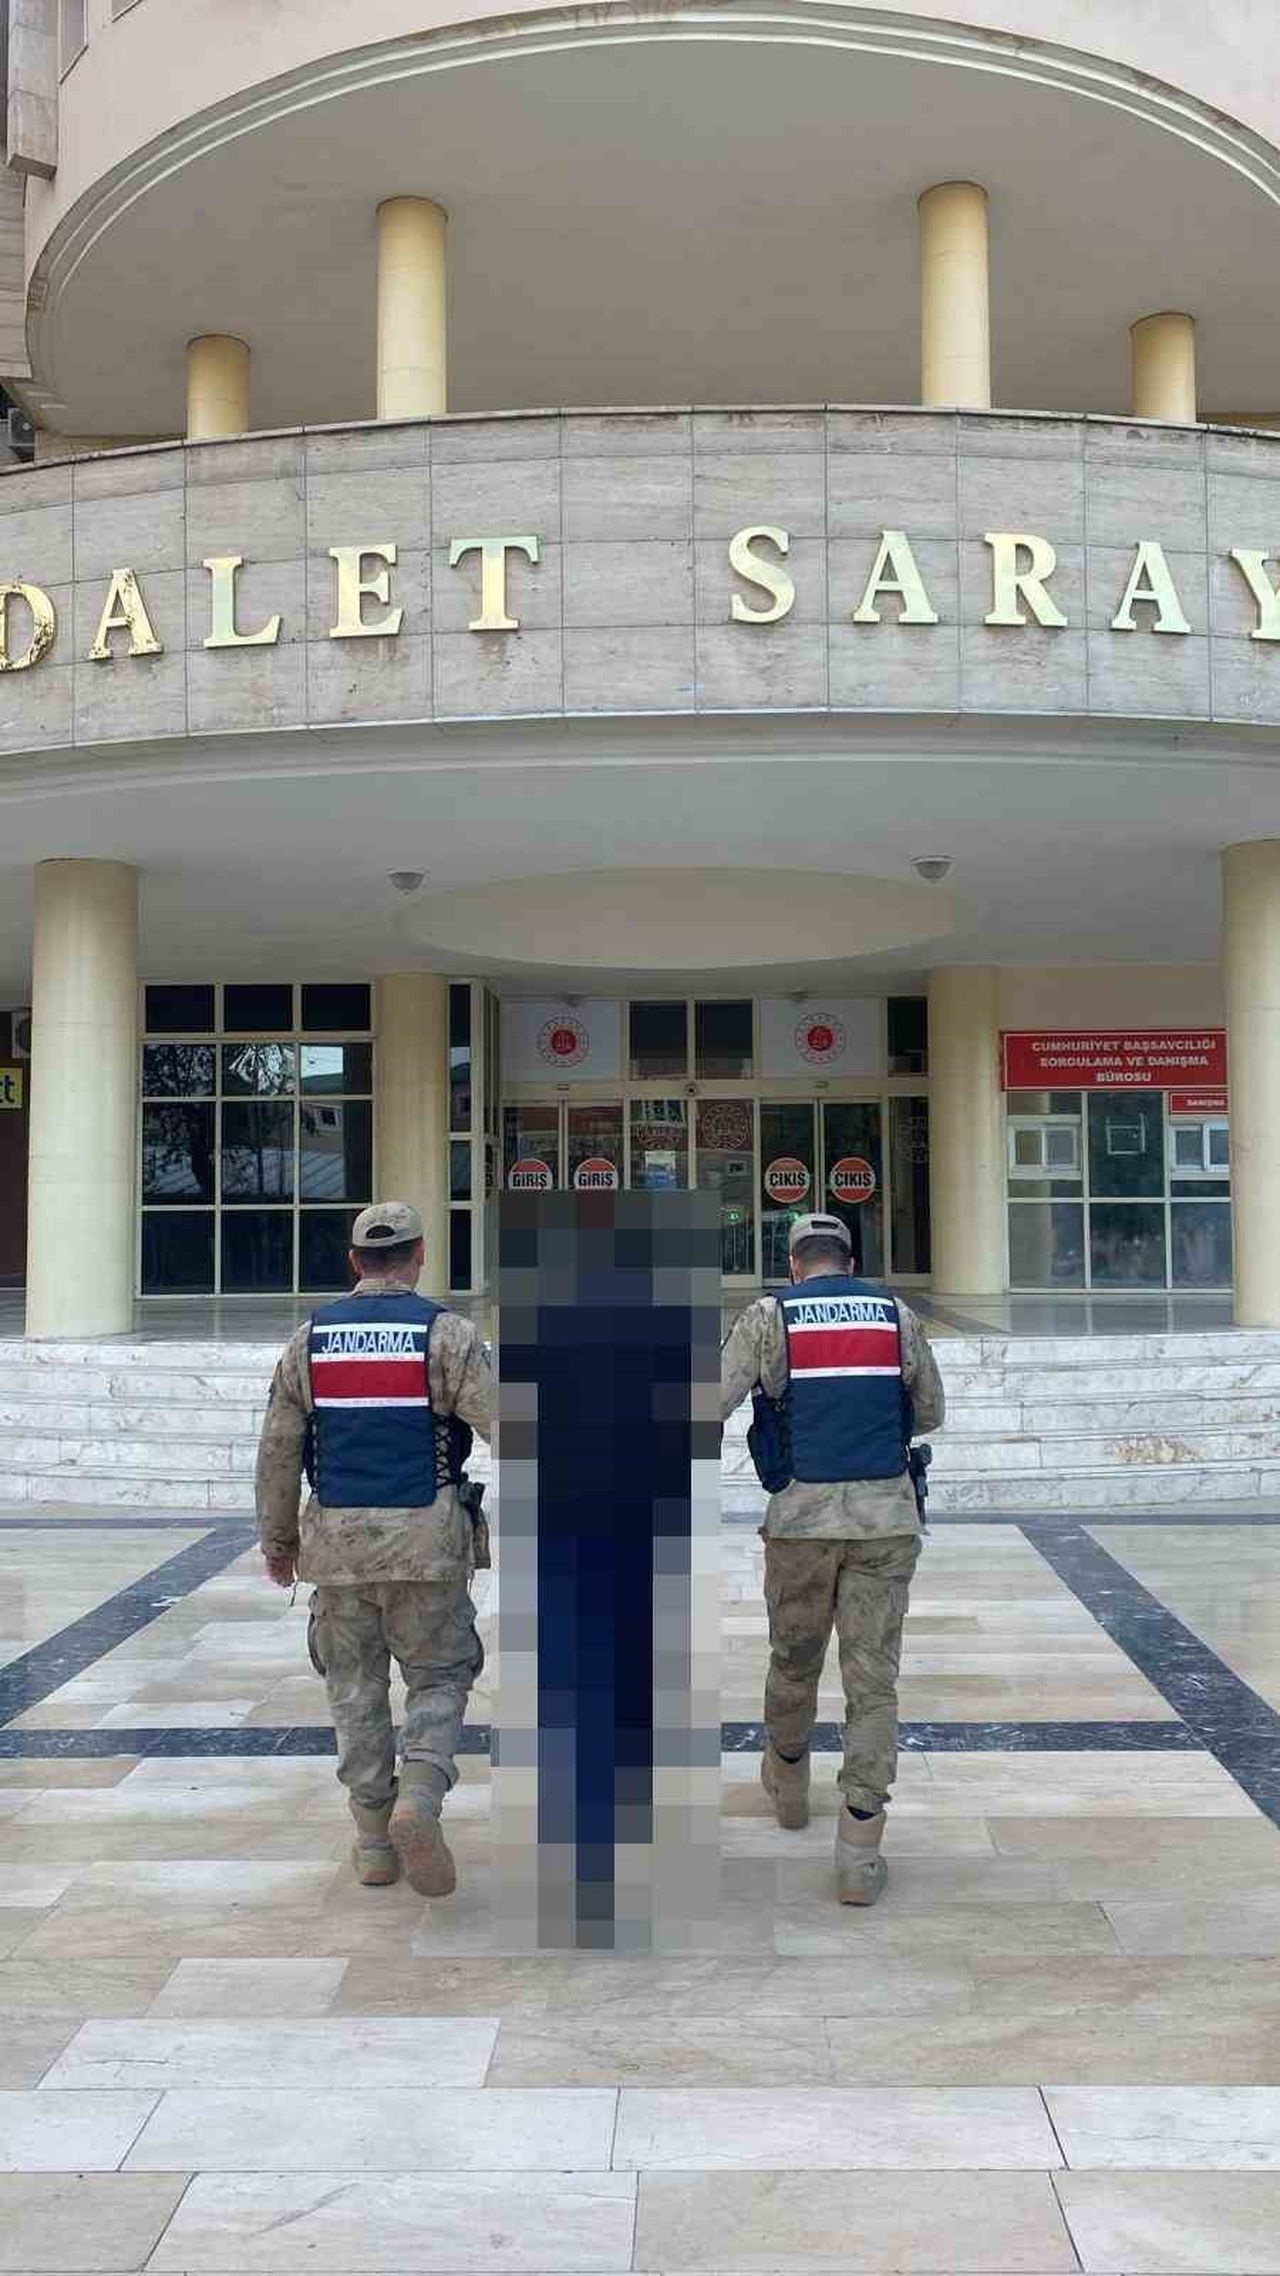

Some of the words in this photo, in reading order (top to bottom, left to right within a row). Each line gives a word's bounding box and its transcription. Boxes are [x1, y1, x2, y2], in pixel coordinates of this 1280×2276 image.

[1126, 1056, 1144, 1066] VE
[1096, 1071, 1152, 1082] BÜROSU
[794, 1302, 888, 1325] JANDARMA
[321, 1330, 416, 1354] JANDARMA
